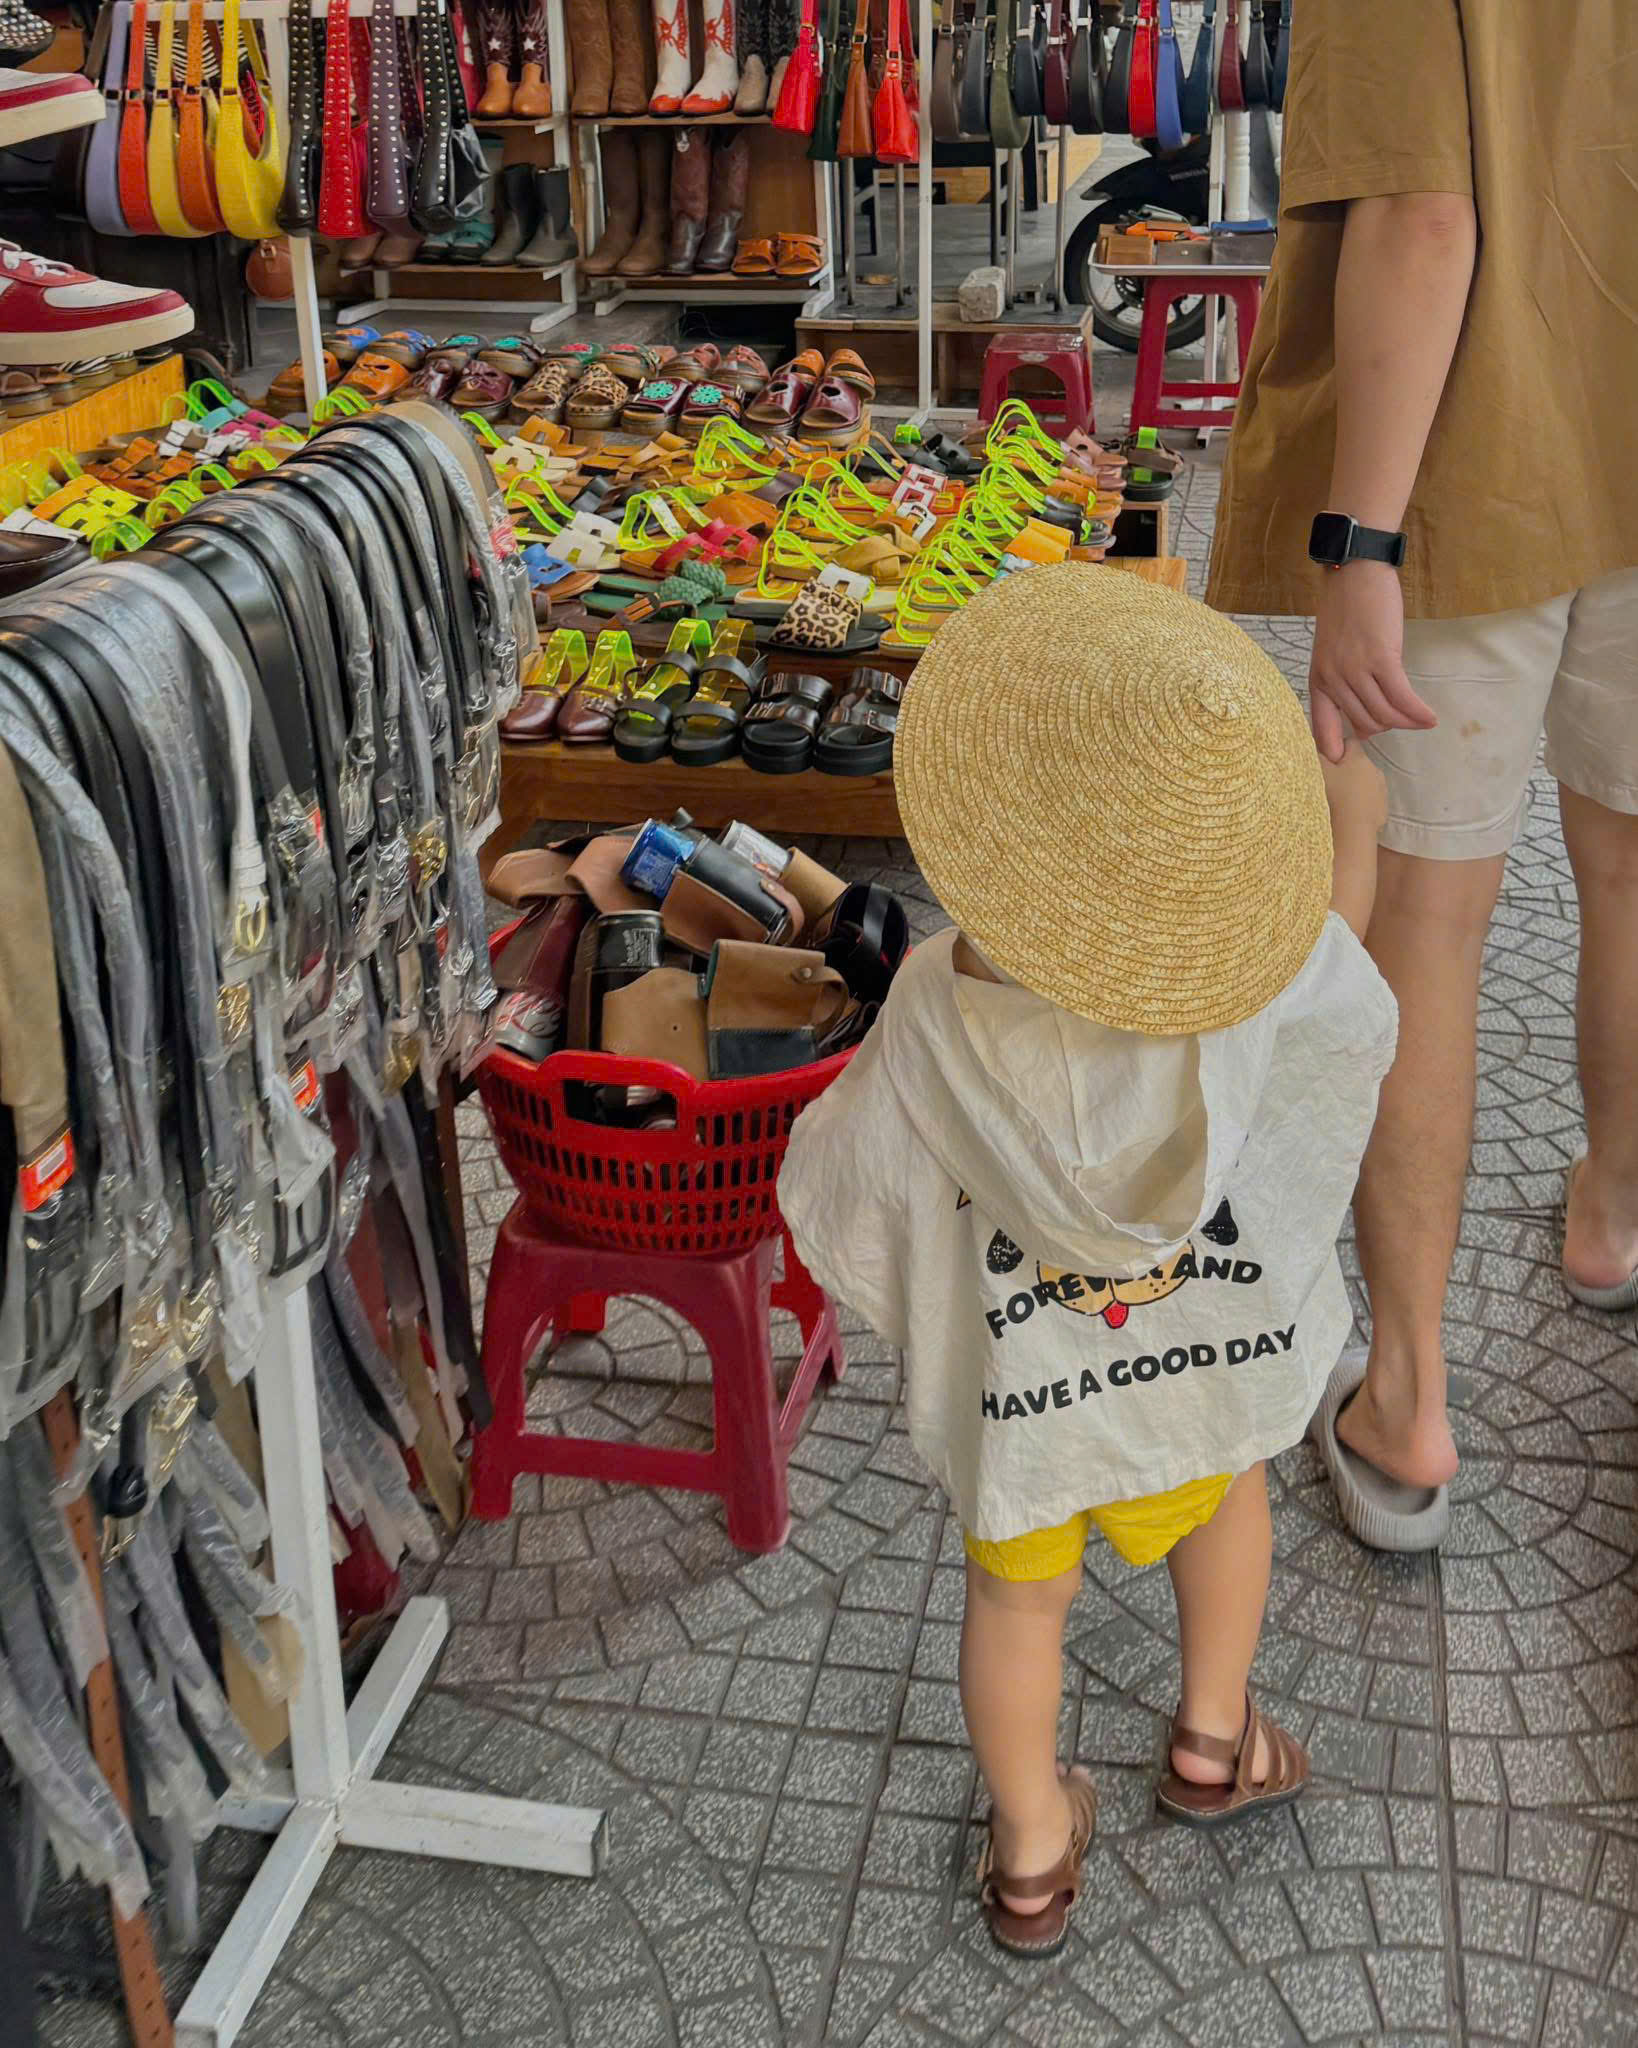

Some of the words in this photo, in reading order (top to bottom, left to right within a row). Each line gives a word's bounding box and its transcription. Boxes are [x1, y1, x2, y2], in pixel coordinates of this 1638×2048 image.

[1170, 1253, 1263, 1285] AND
[981, 1377, 1073, 1420] HAVE
[1079, 1368, 1103, 1401] A
[1107, 1343, 1217, 1386] GOOD
[1225, 1322, 1296, 1366] DAY
